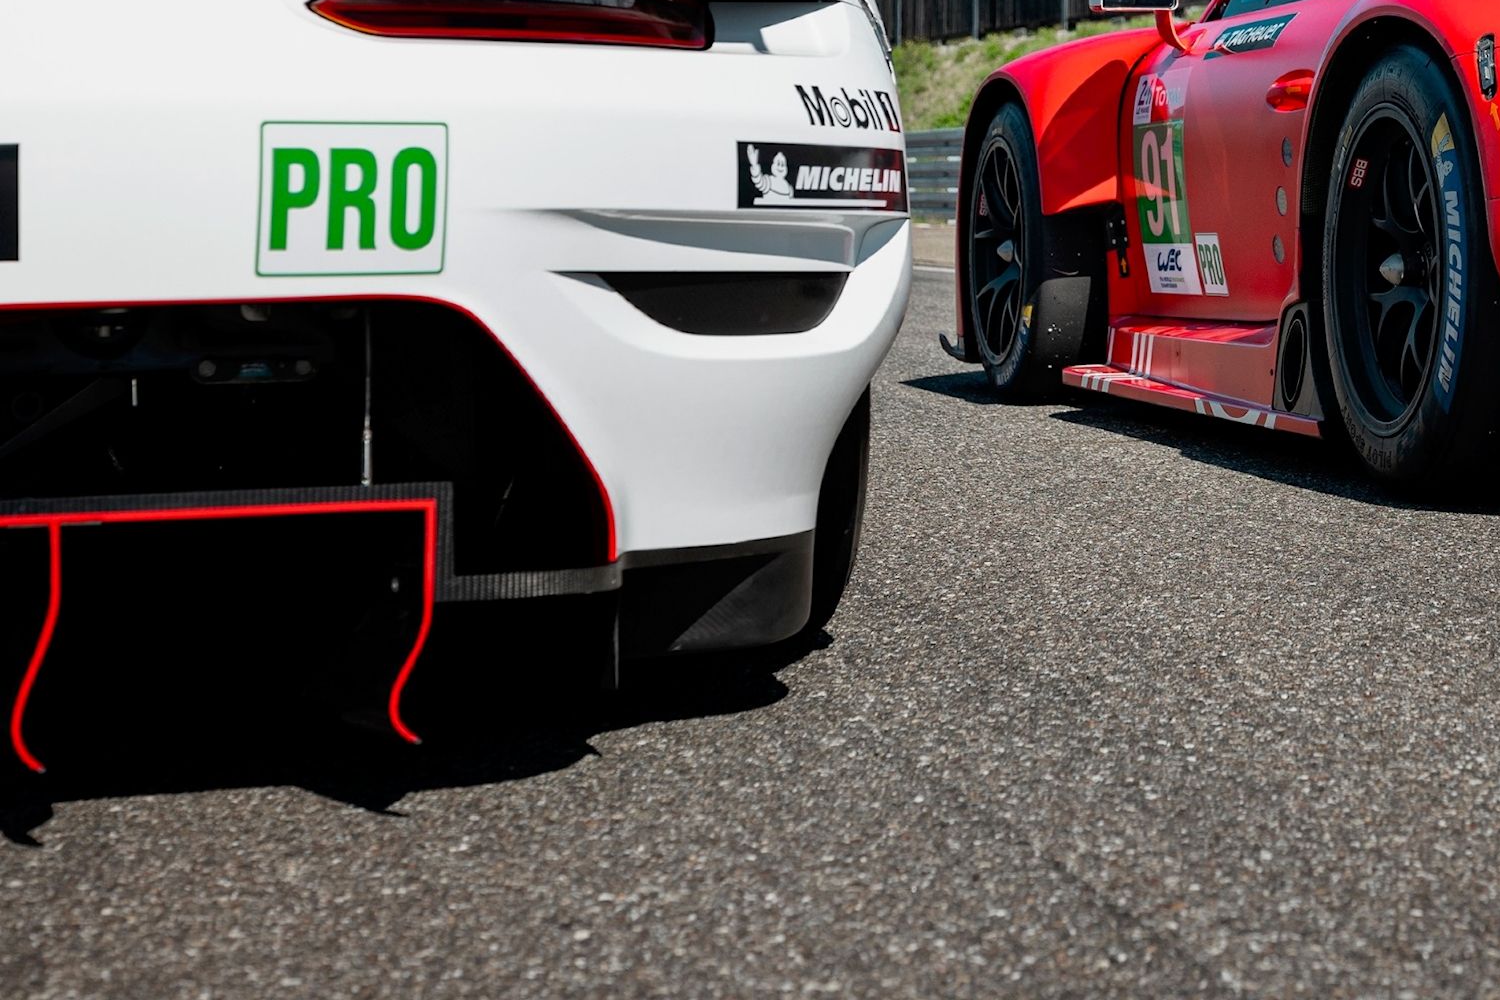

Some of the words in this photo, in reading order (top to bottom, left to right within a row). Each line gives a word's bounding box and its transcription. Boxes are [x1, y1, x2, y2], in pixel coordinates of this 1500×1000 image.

[794, 84, 884, 130] Mobil
[795, 165, 901, 193] MICHELIN
[1141, 126, 1181, 237] 91
[1351, 158, 1368, 188] BBS
[268, 147, 438, 253] PRO
[1198, 243, 1225, 286] PRO
[1438, 190, 1462, 393] MICHELIN
